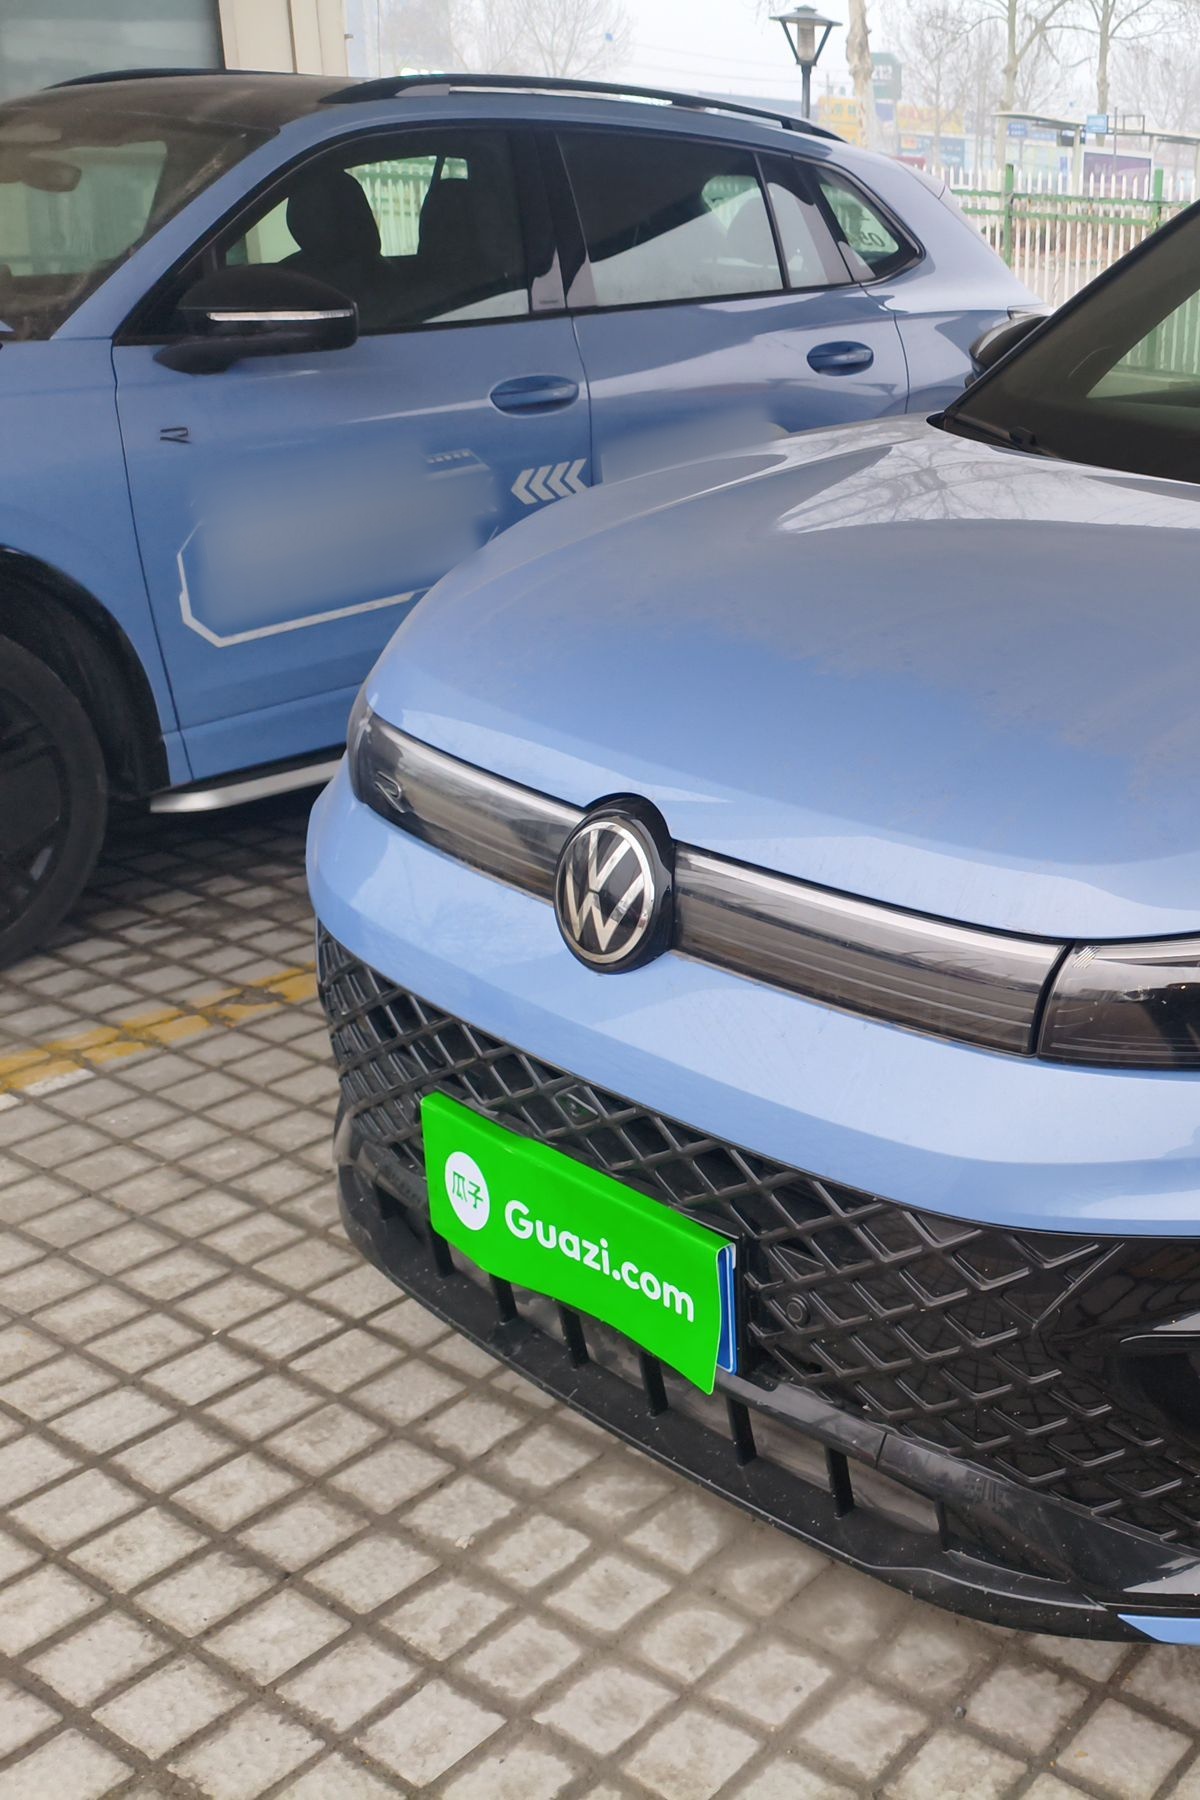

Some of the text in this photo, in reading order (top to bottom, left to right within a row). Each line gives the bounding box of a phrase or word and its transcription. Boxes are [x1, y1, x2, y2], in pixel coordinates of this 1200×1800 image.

[559, 824, 651, 958] VW
[452, 1171, 484, 1208] 瓜子
[505, 1200, 694, 1322] Guazi.com
